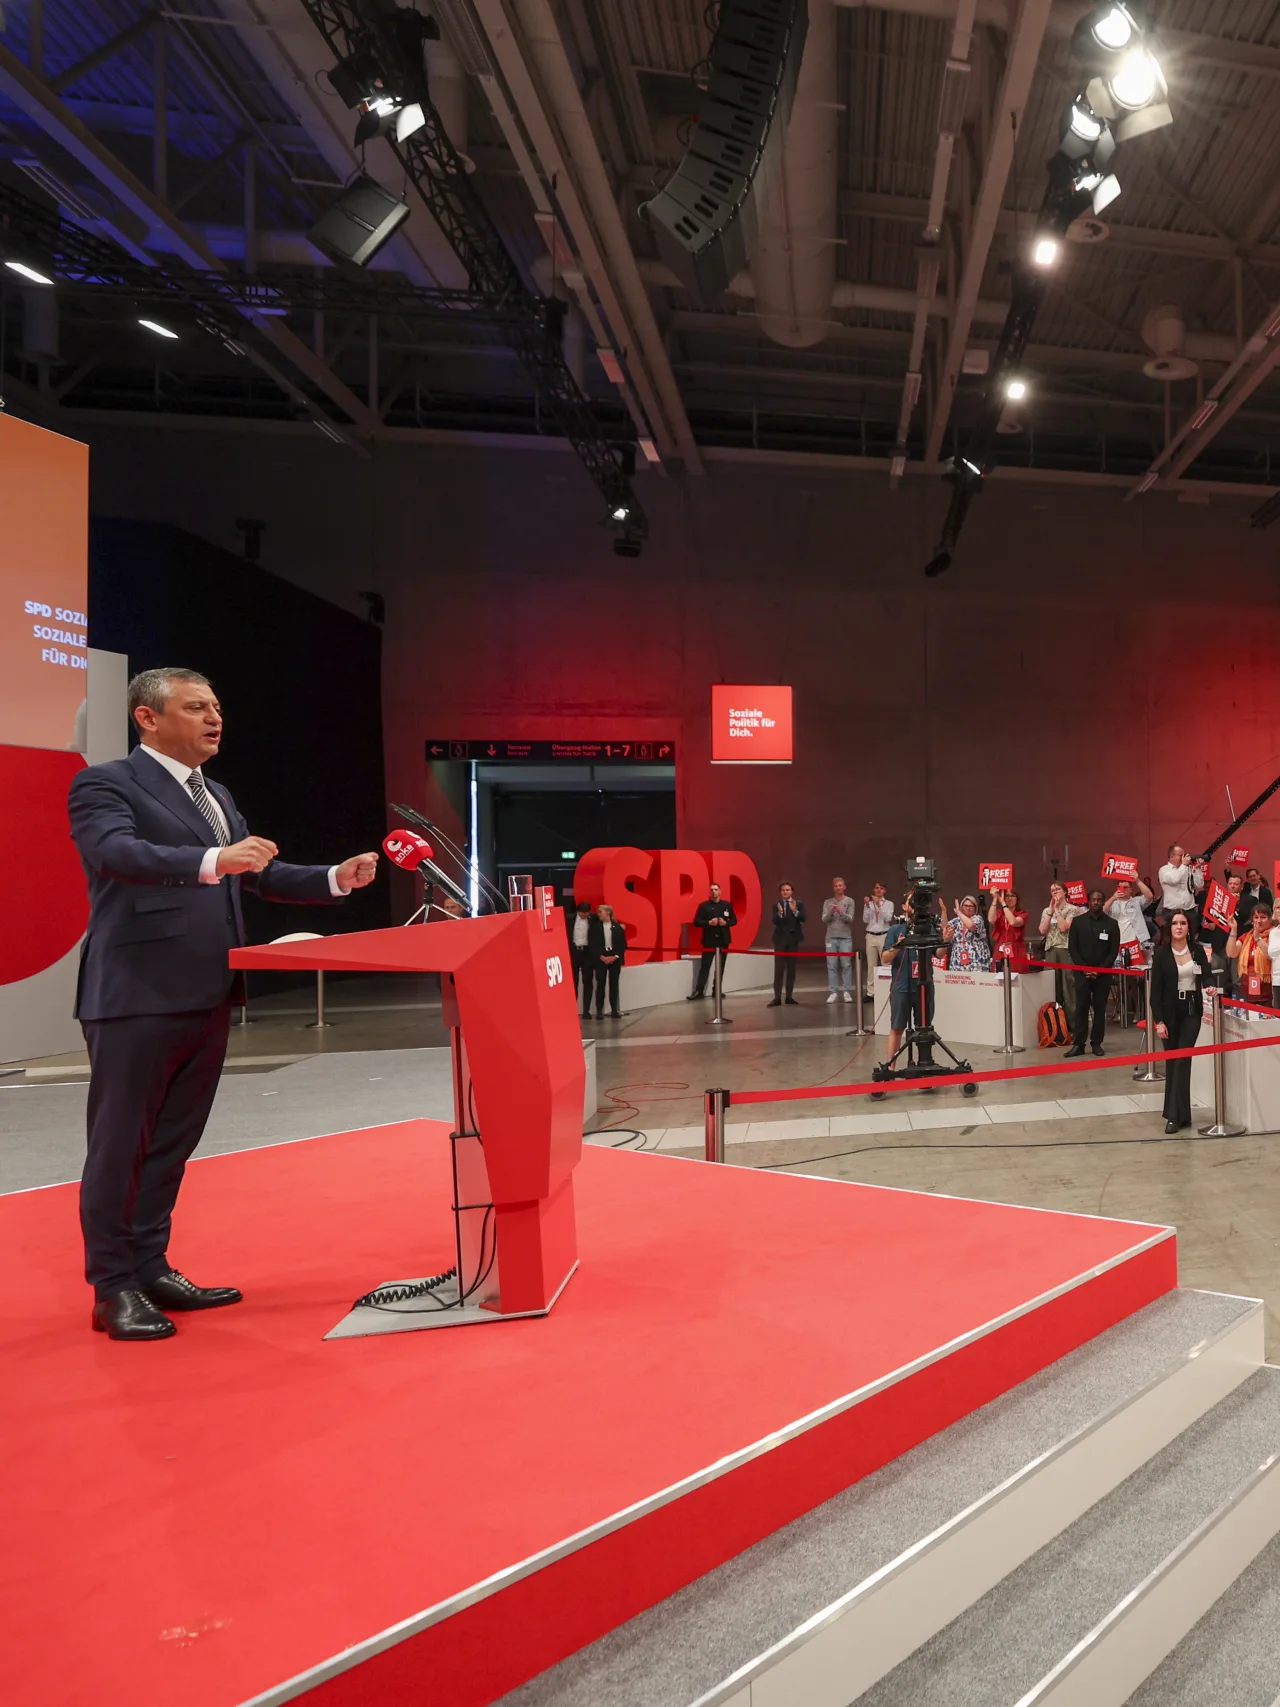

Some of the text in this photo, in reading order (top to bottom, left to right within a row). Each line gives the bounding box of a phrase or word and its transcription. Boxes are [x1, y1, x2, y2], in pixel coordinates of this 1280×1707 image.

[24, 600, 88, 627] SPD SOZI
[33, 624, 87, 648] SOZIALE
[42, 647, 69, 667] FÜR
[728, 708, 763, 718] Soziale
[729, 718, 776, 728] Politik für
[729, 728, 754, 737] Dich.
[1235, 849, 1249, 858] FREE
[1114, 860, 1136, 871] FREE
[989, 867, 1011, 879] FREE
[1067, 884, 1084, 896] FREE
[1212, 885, 1224, 913] FREE
[576, 846, 762, 967] SPD
[1005, 946, 1011, 955] D
[545, 955, 564, 988] SPD
[1251, 979, 1258, 988] D
